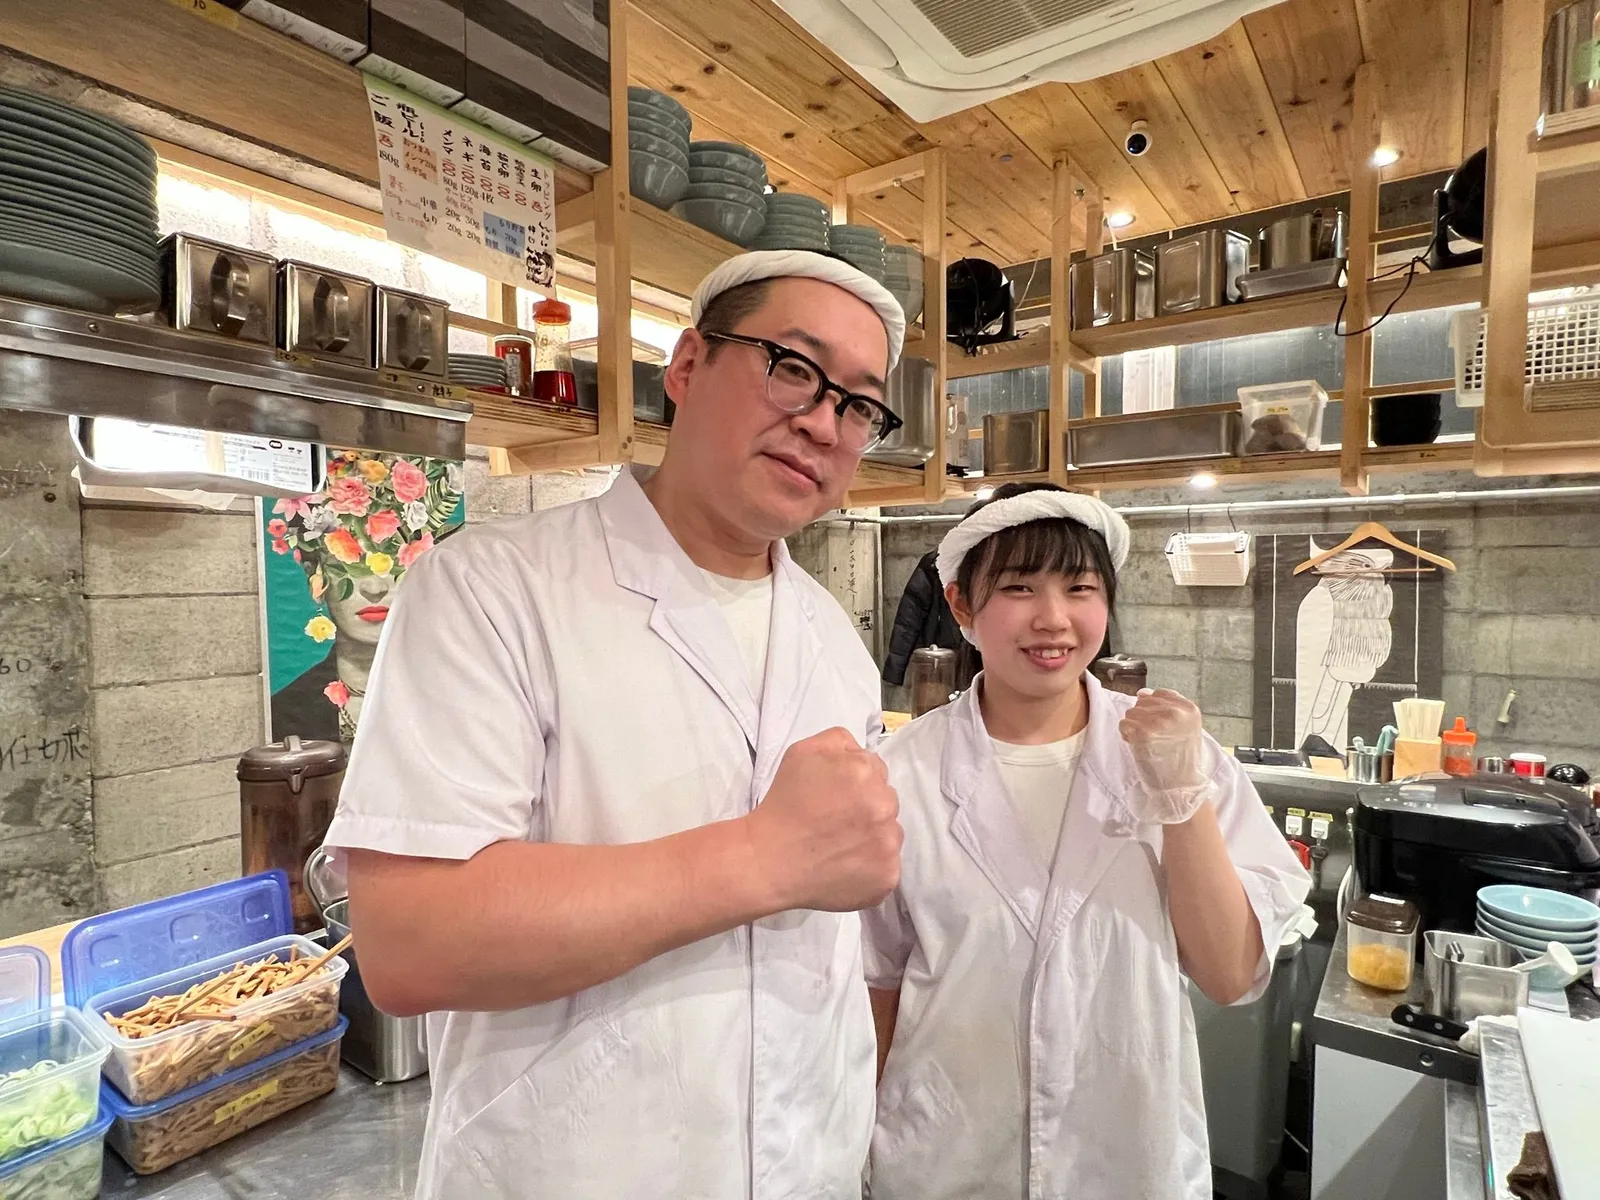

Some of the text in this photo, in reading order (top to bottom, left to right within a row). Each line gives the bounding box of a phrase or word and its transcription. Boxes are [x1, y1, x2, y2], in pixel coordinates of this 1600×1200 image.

[442, 129, 454, 155] メンマ
[462, 135, 474, 162] ネギ
[379, 149, 400, 168] 180g
[479, 143, 492, 171] 海苔
[531, 168, 542, 193] 生卵
[445, 207, 461, 222] 20g
[446, 222, 462, 237] 20g
